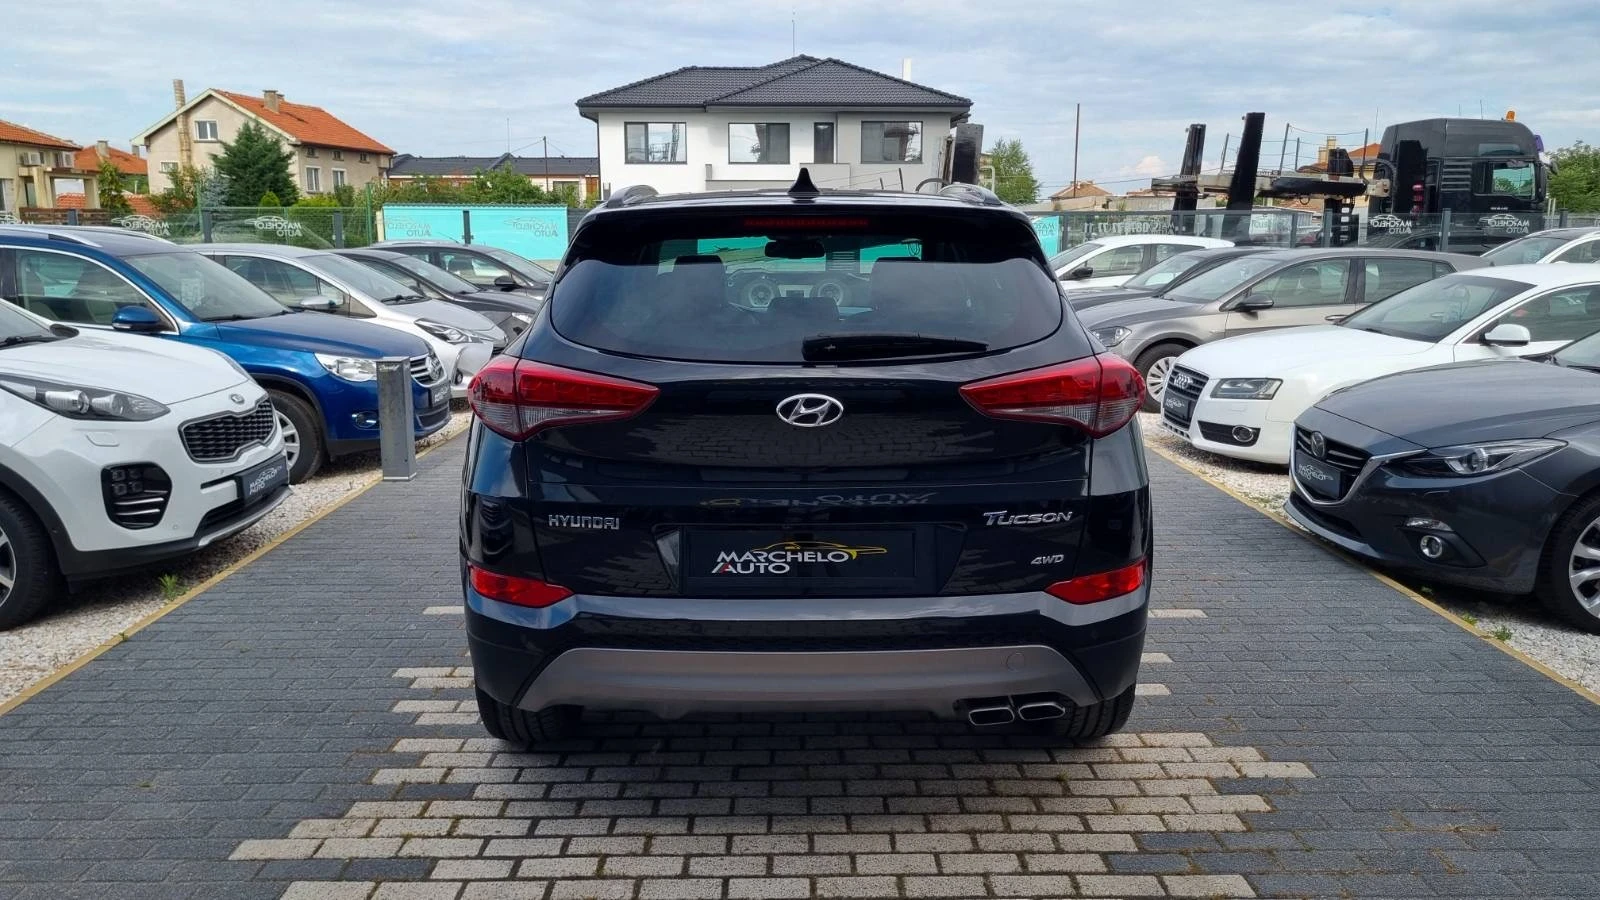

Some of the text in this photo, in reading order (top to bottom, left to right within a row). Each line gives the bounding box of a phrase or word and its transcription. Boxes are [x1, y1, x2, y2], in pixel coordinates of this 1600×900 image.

[548, 514, 620, 530] HYUNDAI
[983, 510, 1073, 526] TUCSON
[716, 551, 849, 563] MARCHELO
[1030, 554, 1064, 566] 4WD
[711, 562, 790, 574] AUTO
